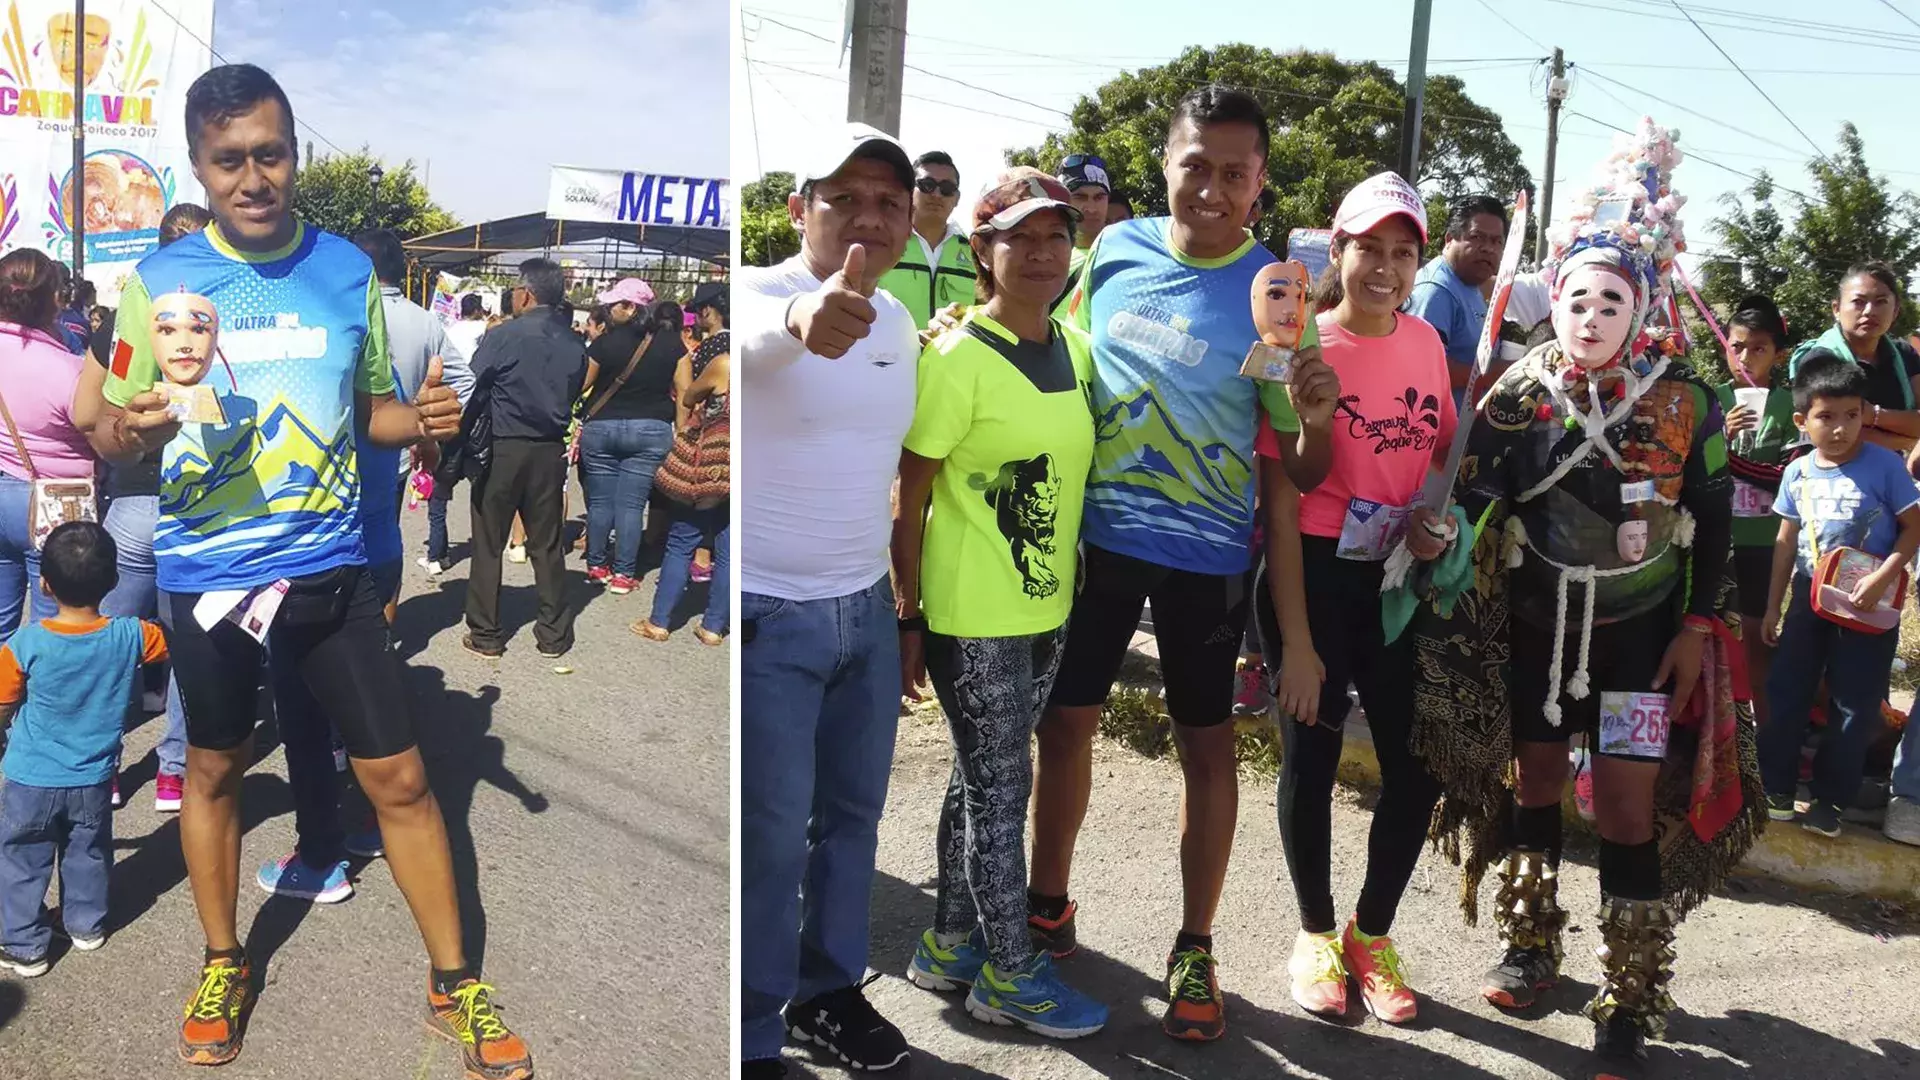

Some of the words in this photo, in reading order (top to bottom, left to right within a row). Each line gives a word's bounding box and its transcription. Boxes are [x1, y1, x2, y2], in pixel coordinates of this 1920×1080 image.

[0, 86, 157, 126] CARNAVAL
[130, 127, 157, 138] 2017
[565, 195, 597, 205] SOLANA
[618, 173, 721, 226] META
[234, 315, 277, 330] ULTRA
[1136, 303, 1173, 325] ULTRA
[1349, 411, 1410, 439] Carnaval
[1367, 433, 1412, 454] Zoque
[1350, 498, 1374, 515] LIBRE
